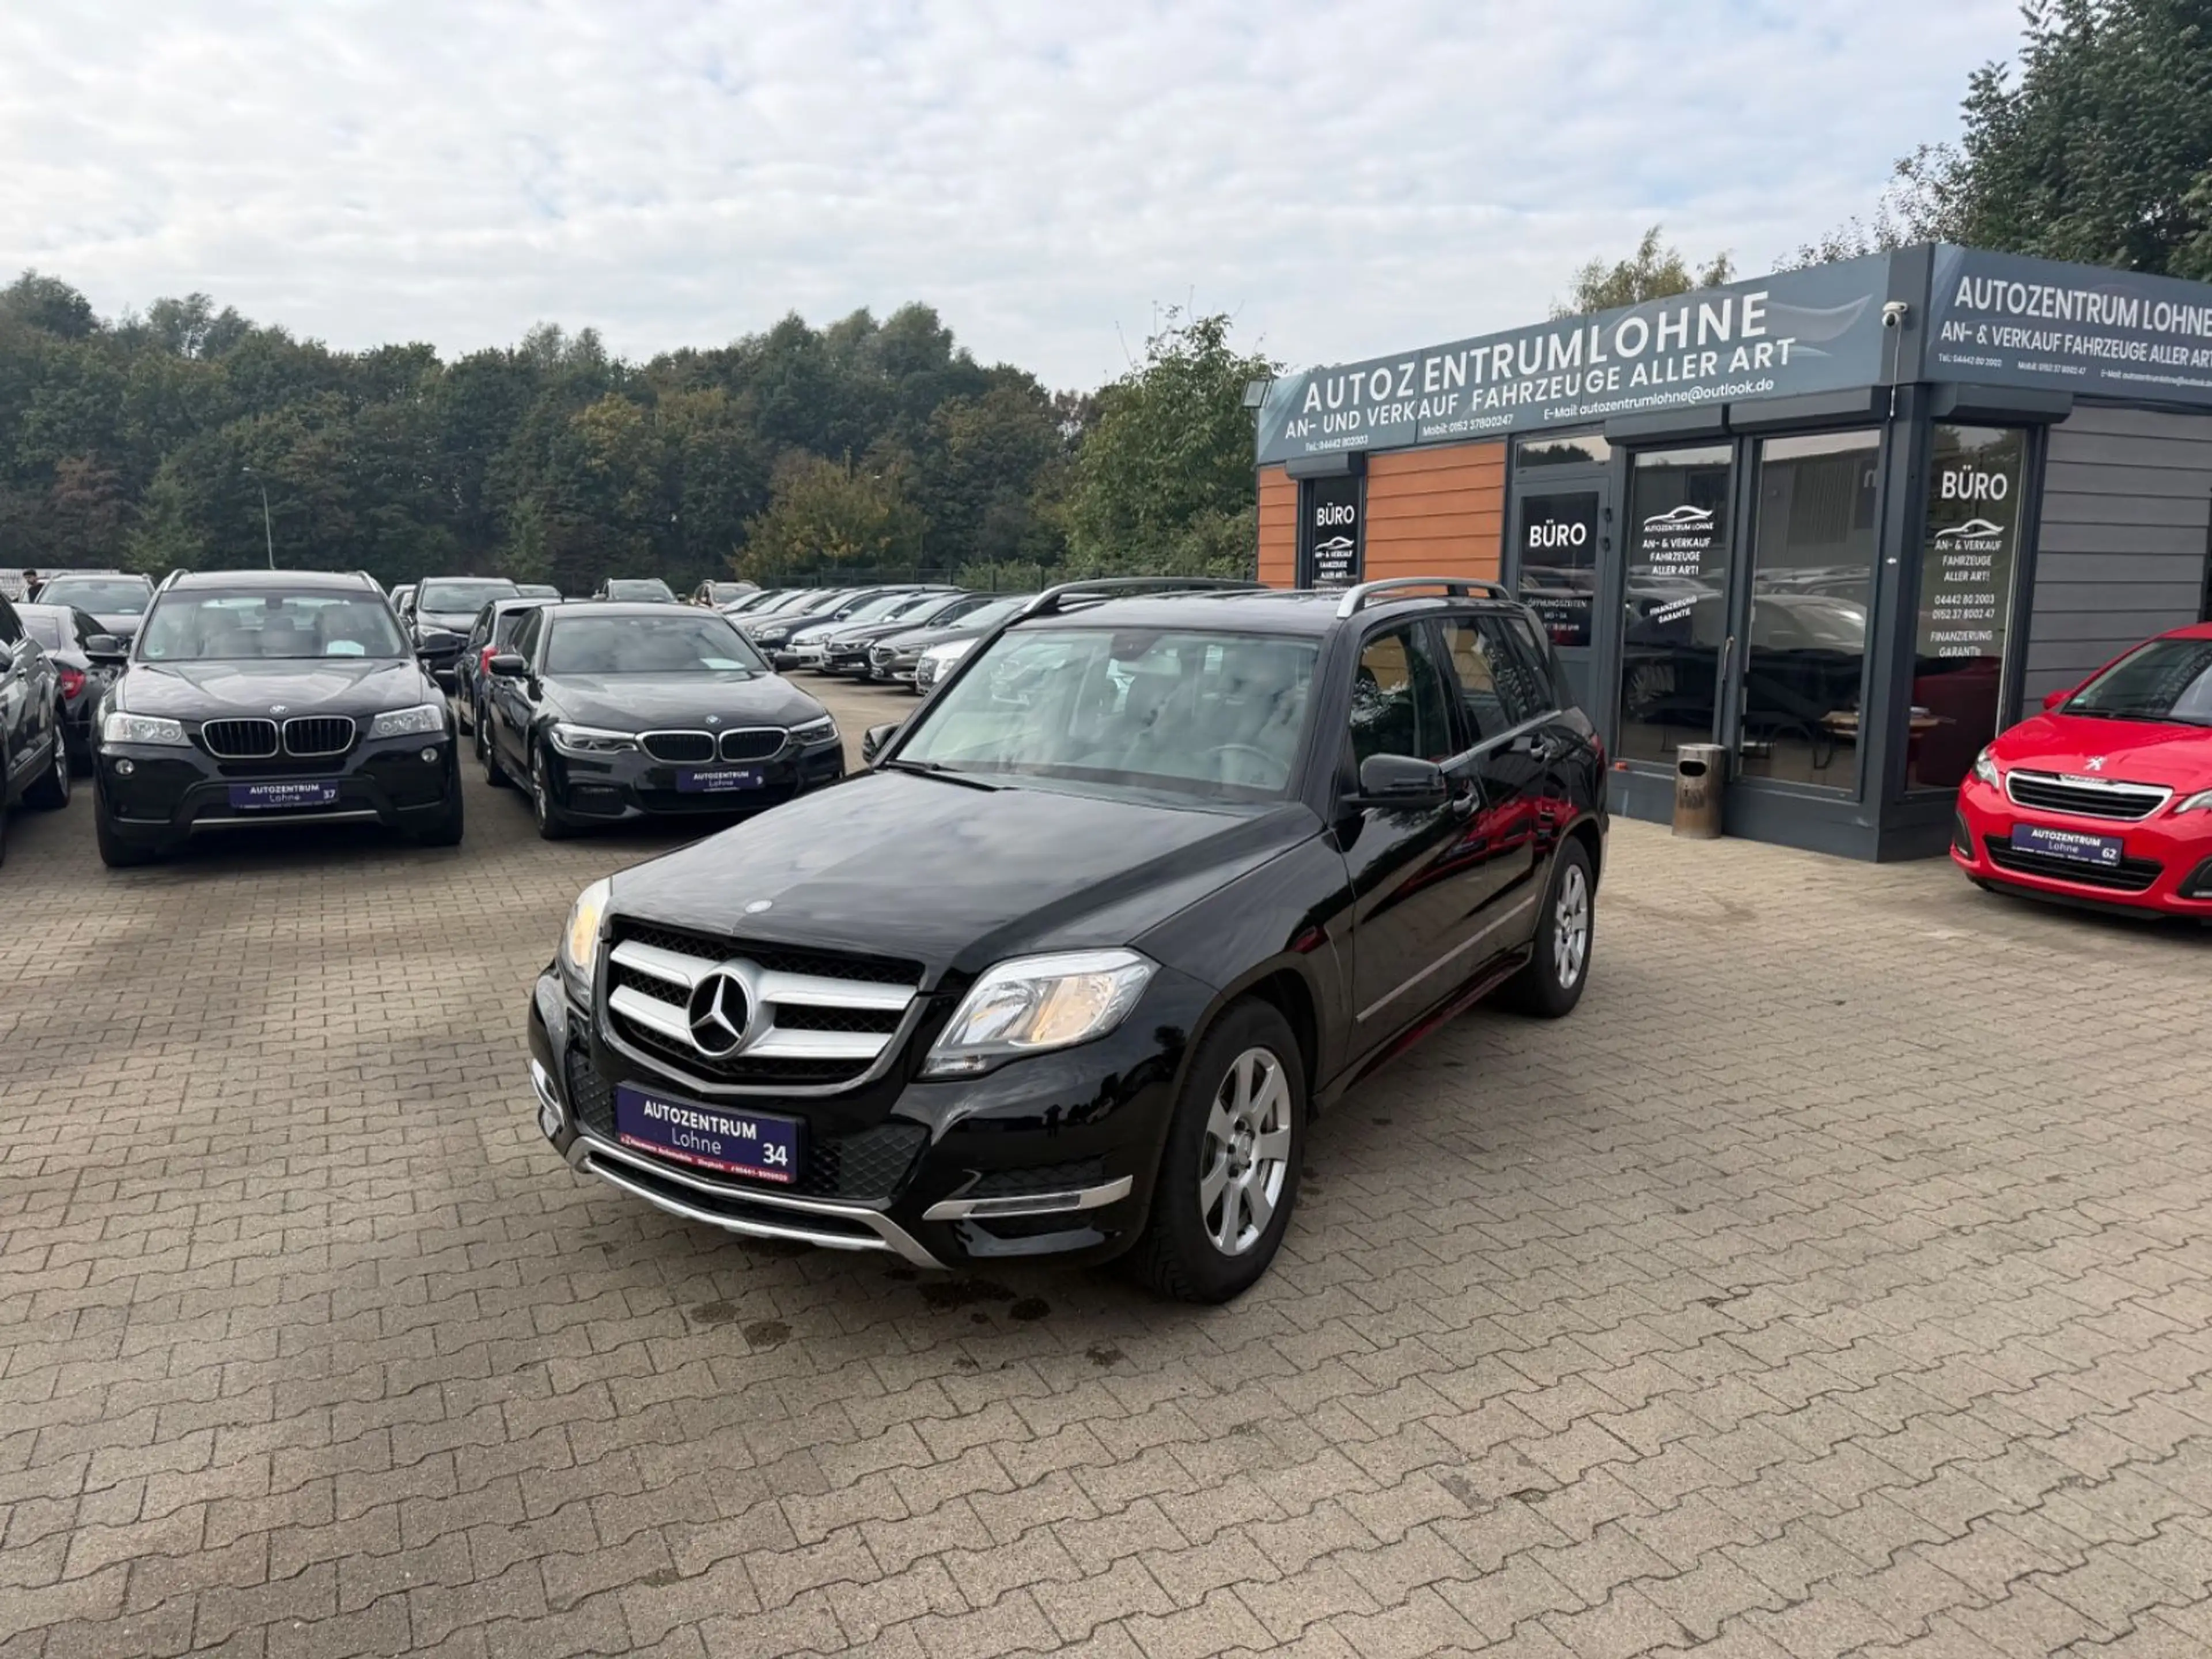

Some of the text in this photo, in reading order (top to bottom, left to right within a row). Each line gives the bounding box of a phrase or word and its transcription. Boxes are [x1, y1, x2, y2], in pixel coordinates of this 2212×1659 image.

[1955, 275, 2212, 336] AUTOZENTRUM LOHNE
[1976, 324, 1988, 344] &
[1992, 325, 2062, 352] VERKAUF
[2064, 334, 2148, 361] FAHRZEUGE
[2149, 344, 2190, 365] ALLER
[1323, 410, 1361, 433] UND
[1366, 393, 1459, 427] VERKAUF
[1472, 364, 1620, 411] FAHRZEUGE
[1629, 350, 1718, 388] ALLER
[1728, 336, 1797, 373] ART
[1941, 465, 2008, 500] BÜRO
[1316, 502, 1354, 527] BÜRO
[1529, 520, 1586, 548] BÜRO
[1671, 536, 1711, 548] VERKAUF
[1963, 540, 2002, 551] VERKAUF
[1649, 551, 1700, 562] FAHRZEUGE
[1942, 555, 1991, 566] FAHRZEUGE
[1652, 565, 1677, 575] ALLER
[1944, 570, 1968, 581] ALLER
[1930, 630, 1993, 642] FINANZIERUNG
[250, 784, 319, 794] AUTOZENTRUM
[2031, 829, 2101, 846] AUTOZENTRUM
[2048, 841, 2080, 853] Lohne
[2101, 847, 2118, 859] 62
[643, 1100, 757, 1140] AUTOZENTRUM
[671, 1127, 722, 1155] Lohne
[762, 1143, 789, 1166] 34
